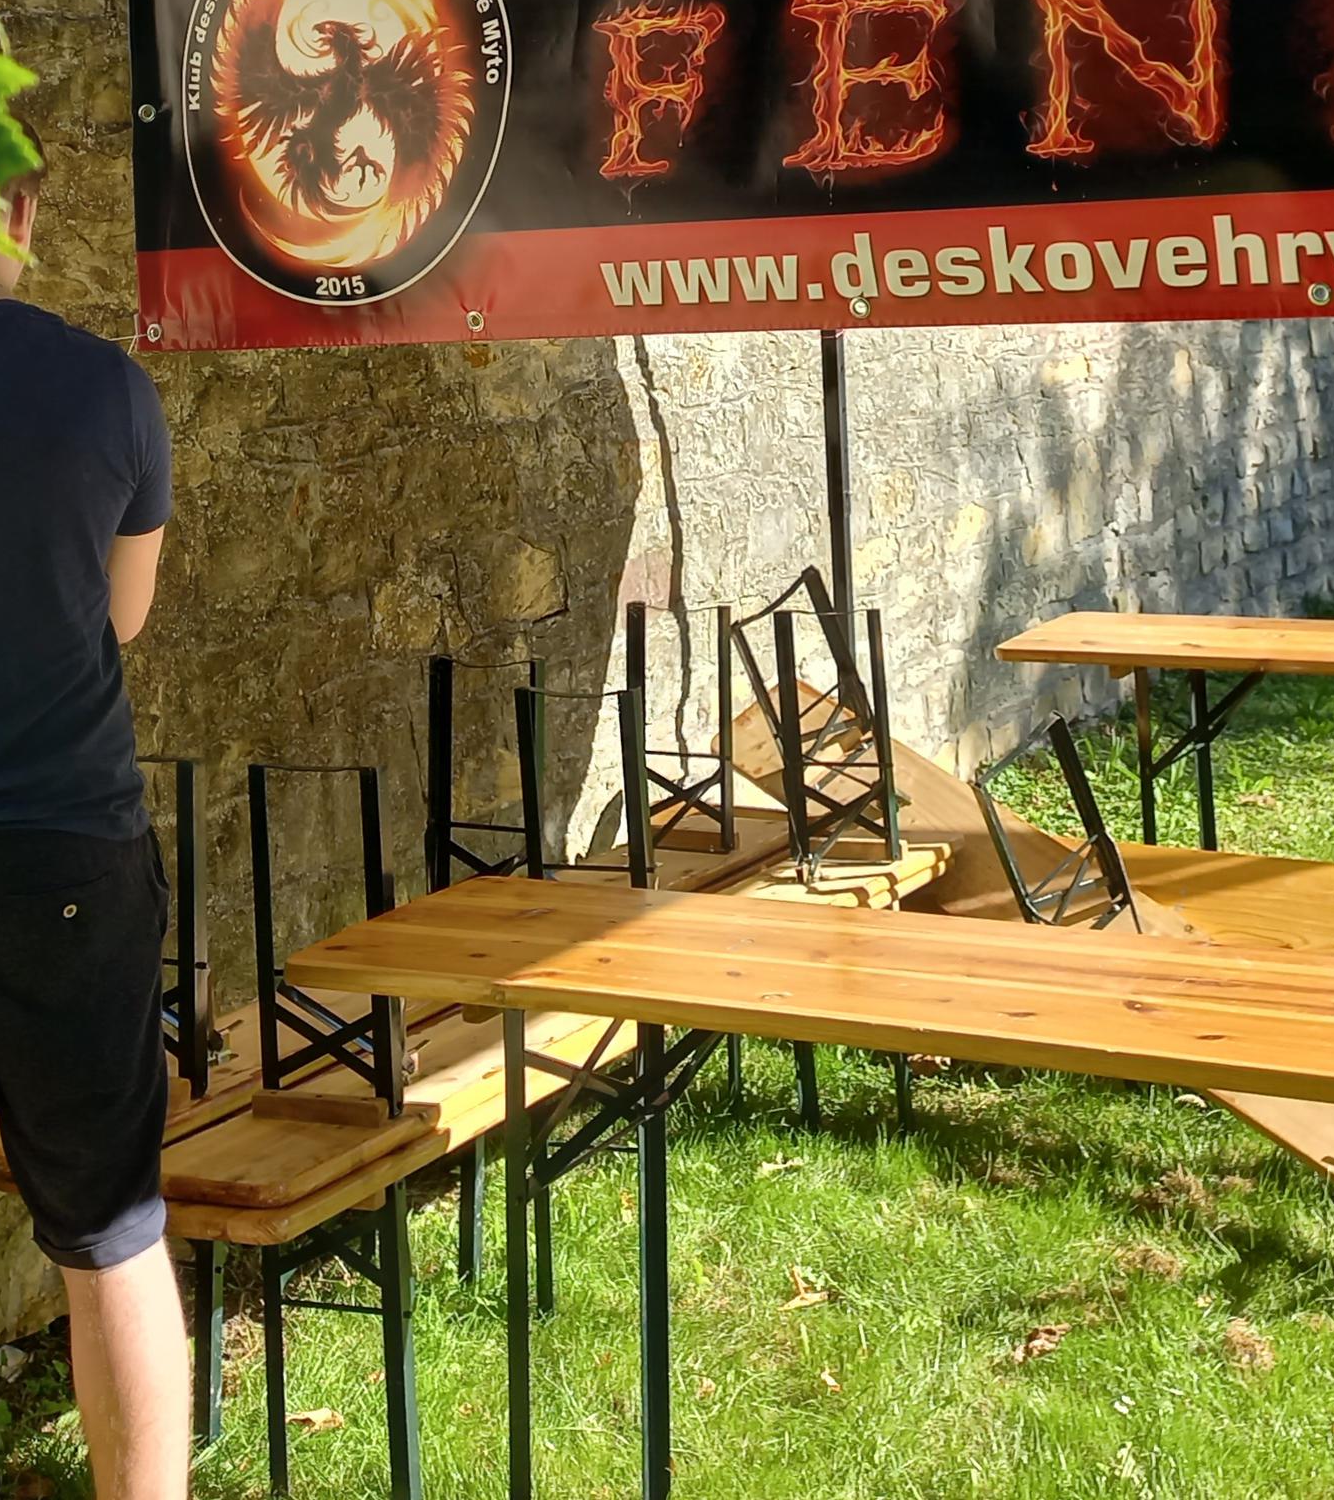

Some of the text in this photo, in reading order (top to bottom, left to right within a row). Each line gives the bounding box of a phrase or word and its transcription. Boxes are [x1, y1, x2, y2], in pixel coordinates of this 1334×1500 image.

[188, 52, 202, 111] Klub
[480, 18, 502, 85] Mýto
[315, 275, 366, 298] 2015
